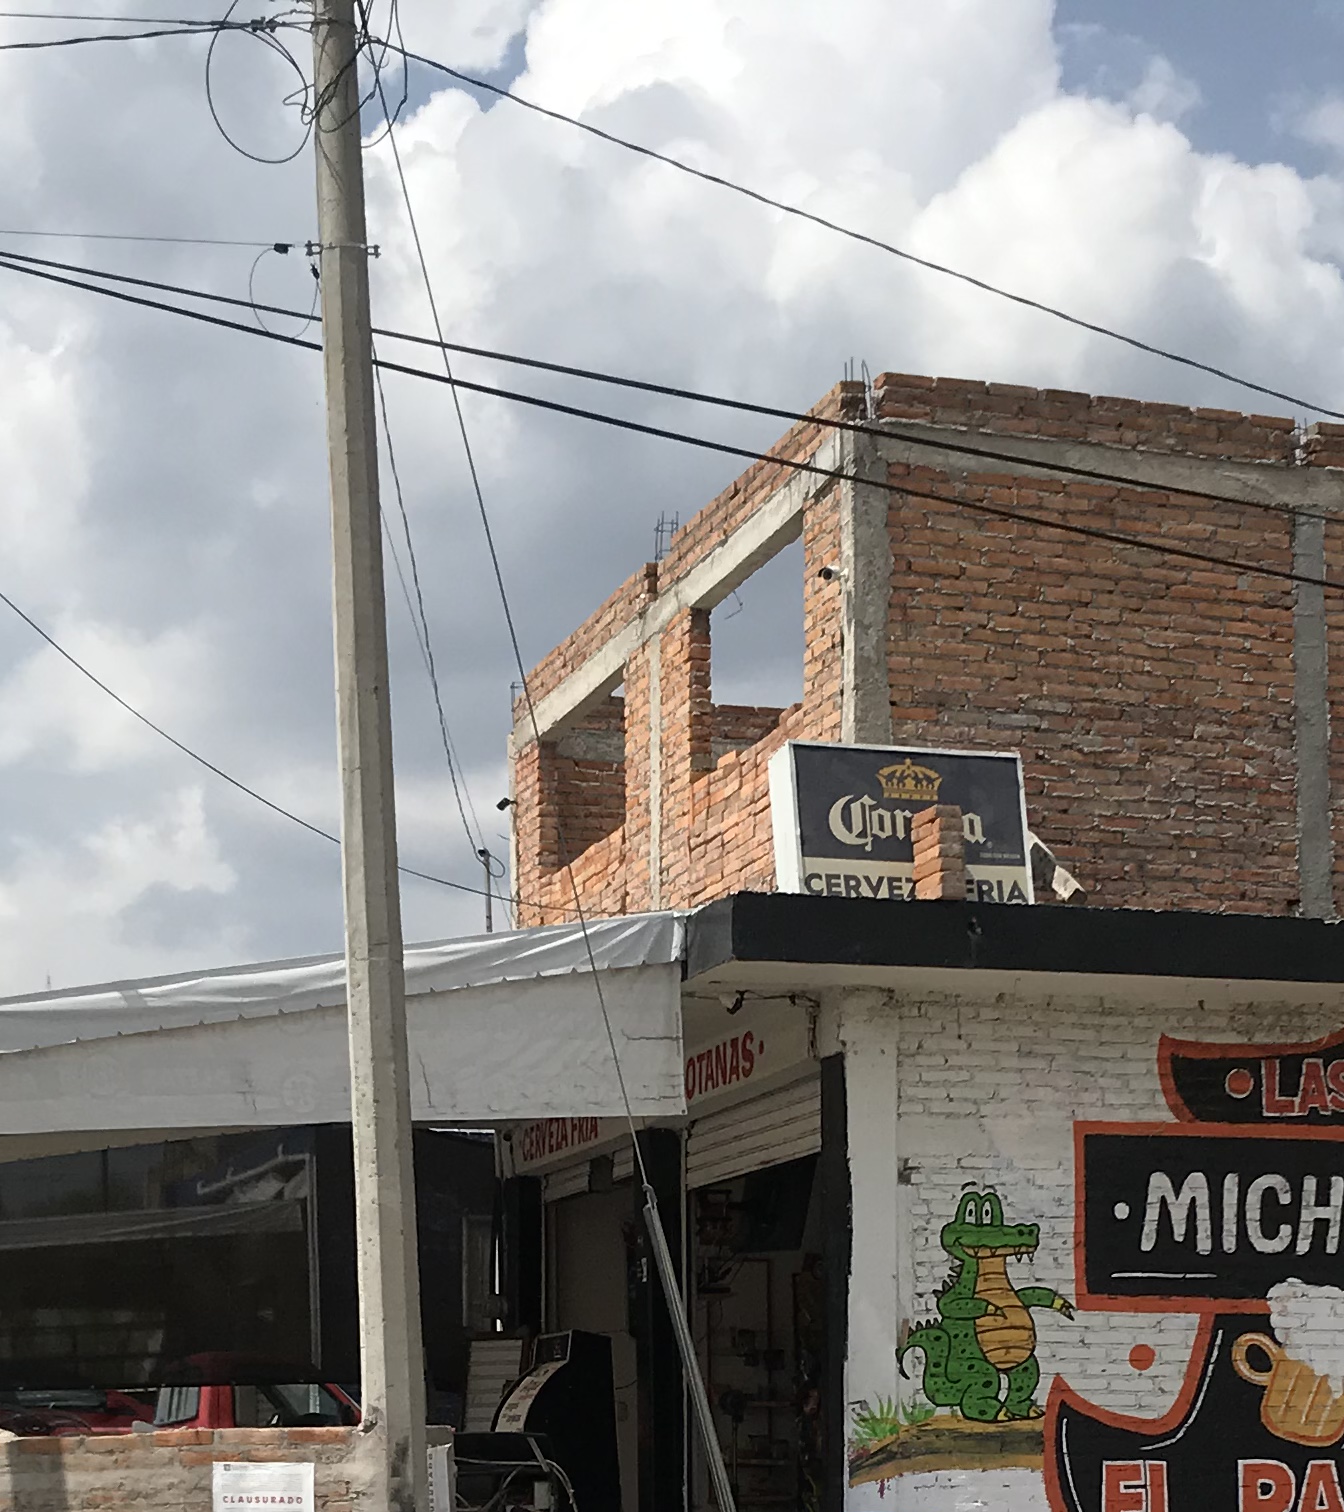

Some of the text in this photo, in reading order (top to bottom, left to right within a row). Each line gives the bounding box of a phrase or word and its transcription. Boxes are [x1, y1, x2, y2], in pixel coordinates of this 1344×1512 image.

[828, 793, 986, 852] Cora
[805, 871, 917, 901] CERVEZ
[684, 1030, 755, 1101] OTANAS
[521, 1117, 569, 1163] CERVEZA
[222, 1495, 304, 1505] CLAUSURADO
